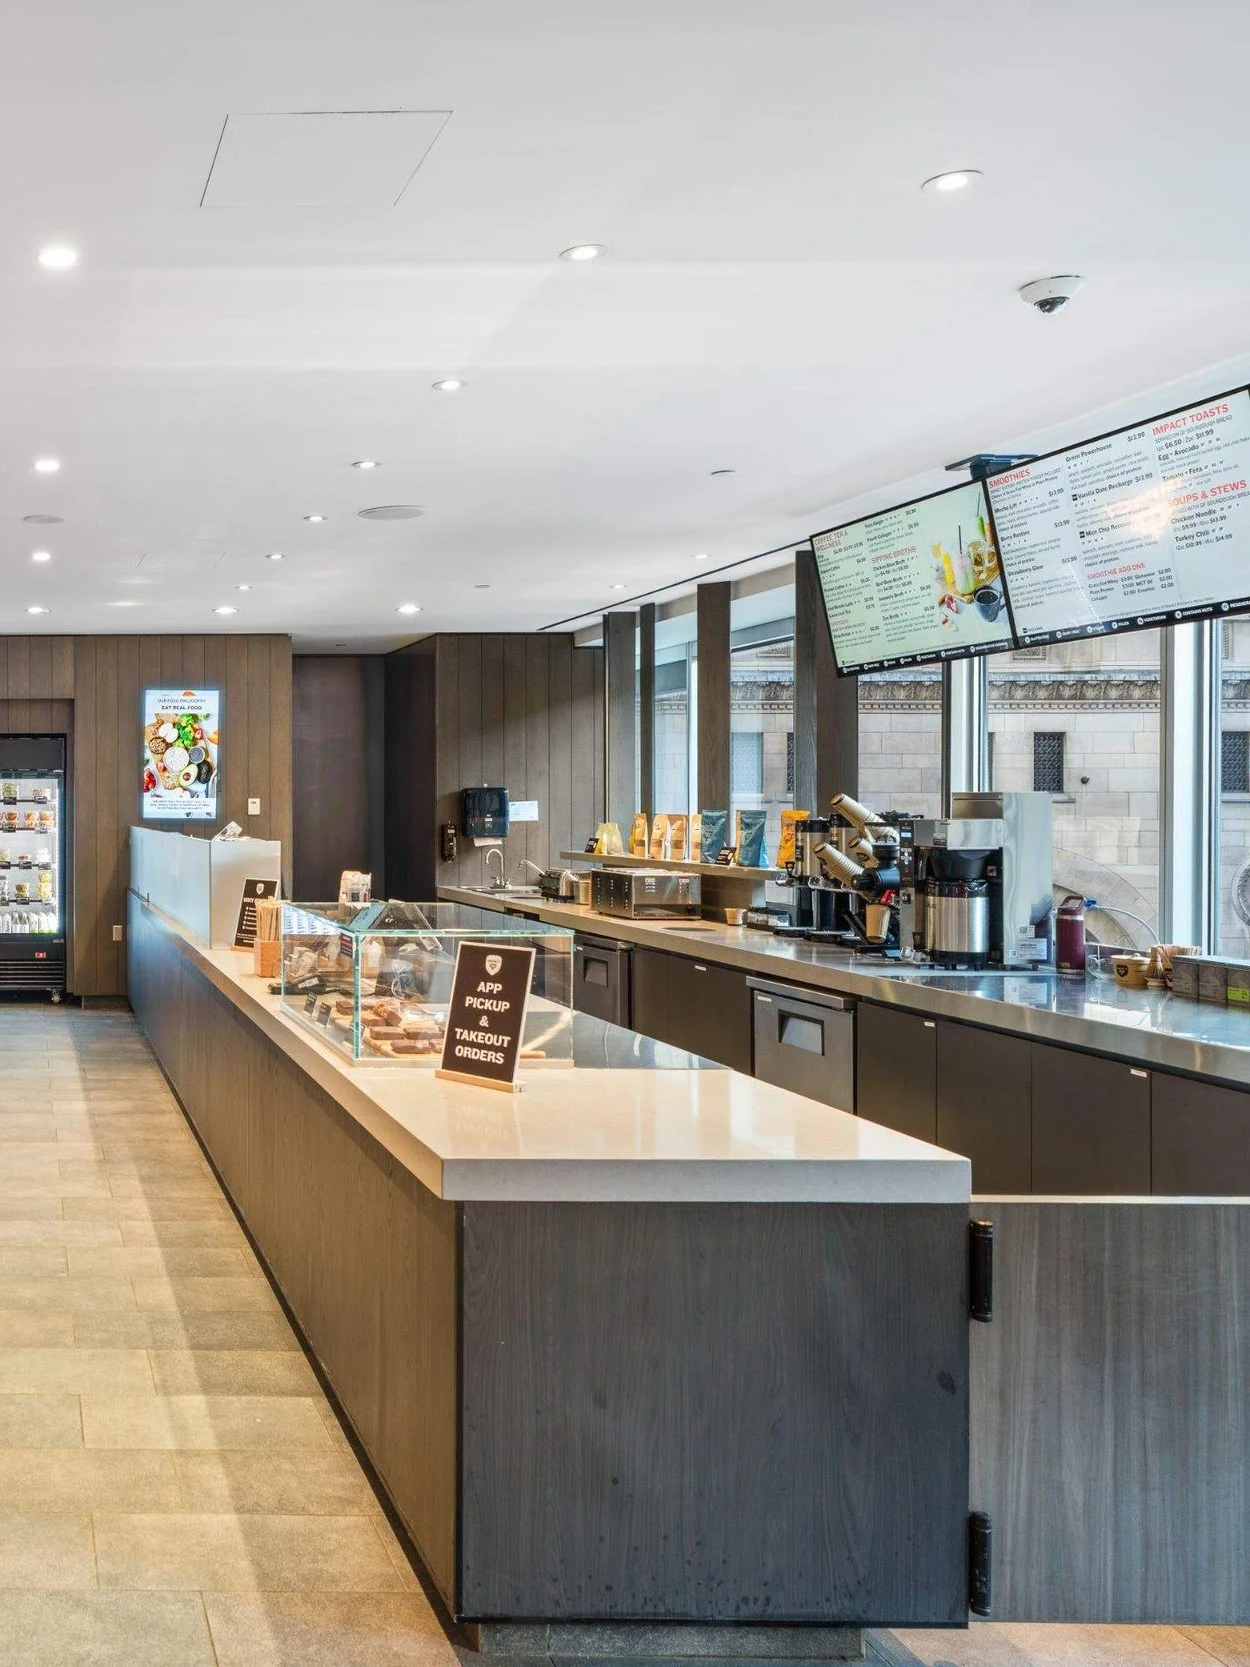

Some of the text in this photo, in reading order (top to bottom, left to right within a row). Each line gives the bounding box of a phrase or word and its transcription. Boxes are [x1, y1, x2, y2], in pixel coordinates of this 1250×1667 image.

[1153, 404, 1228, 435] IMPACT TOASTS
[1165, 439, 1182, 448] $6.50
[1066, 443, 1112, 462] Green Powerhouse
[1158, 444, 1199, 461] Egg Avocado
[1126, 466, 1142, 474] protein
[1163, 466, 1202, 481] Tomato Feta
[989, 470, 1030, 488] SMOOTHIES
[1078, 490, 1094, 499] Vanilla
[1095, 486, 1108, 494] Date
[1108, 479, 1133, 490] Recharge
[1201, 490, 1208, 499] &
[1211, 480, 1246, 496] STEWS
[994, 505, 1009, 513] Mocha
[1171, 509, 1216, 524] Chicken Noodle
[1175, 534, 1194, 542] Turkey
[816, 540, 841, 552] WELLNESS
[871, 553, 893, 563] SIPPING
[893, 546, 917, 557] BROTHS
[1008, 567, 1032, 576] Strawberry
[1087, 569, 1117, 580] SMOOTHIE
[477, 982, 502, 994] APP
[464, 996, 510, 1013] PICKUP
[479, 1016, 489, 1027] &
[454, 1028, 510, 1047] TAKEOUT
[455, 1046, 504, 1064] ORDERS
